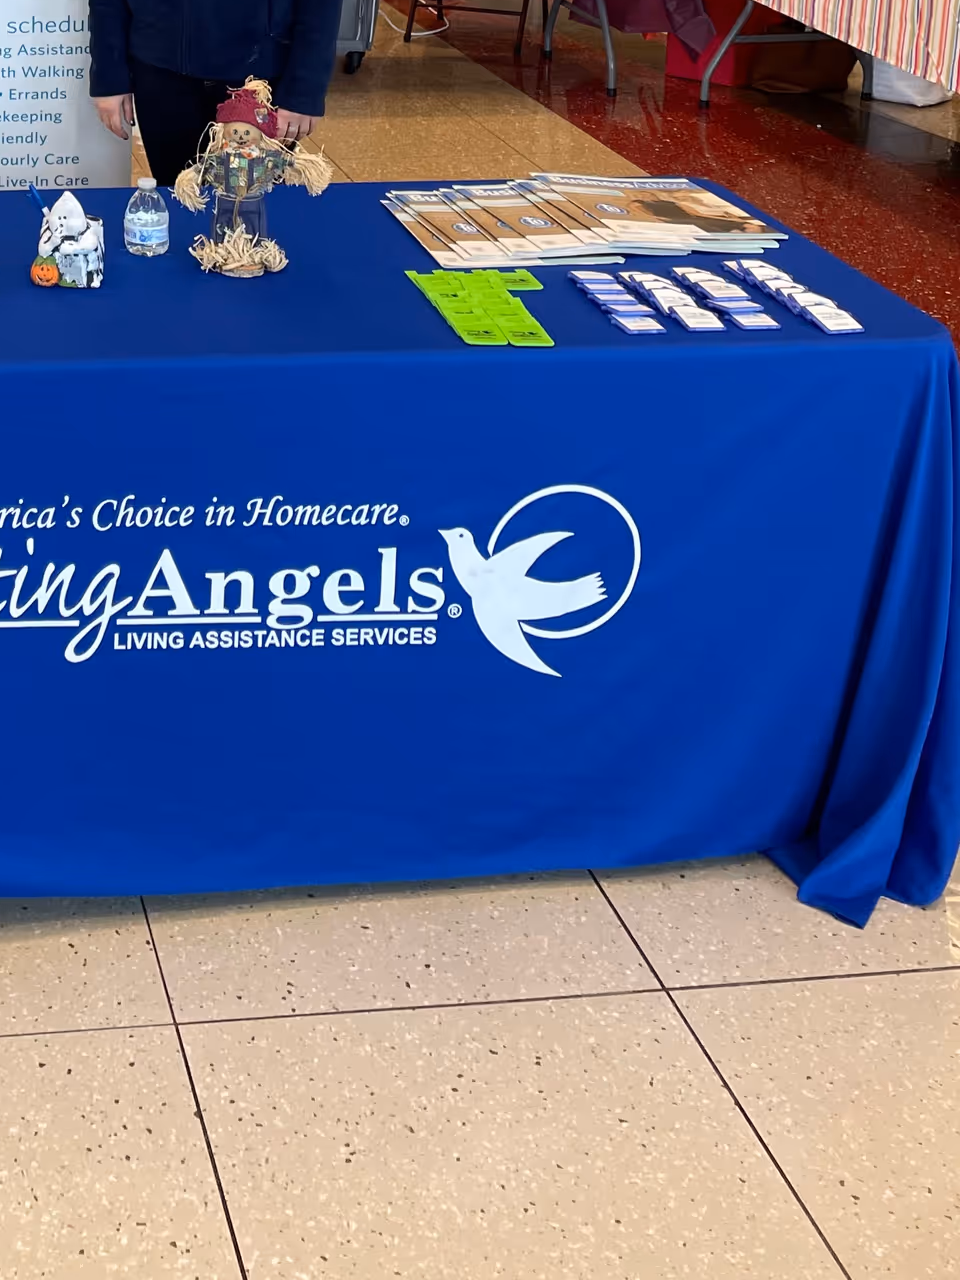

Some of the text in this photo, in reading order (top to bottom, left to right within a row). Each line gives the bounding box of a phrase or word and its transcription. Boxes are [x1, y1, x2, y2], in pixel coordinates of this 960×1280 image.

[21, 64, 85, 81] Walking
[8, 87, 67, 101] Errands
[44, 152, 80, 165] Care
[54, 174, 90, 187] Care
[549, 176, 634, 189] Business
[91, 497, 195, 533] Choice
[204, 495, 235, 528] in
[114, 627, 437, 650] LIVING ASSISTANCE SERVICES
